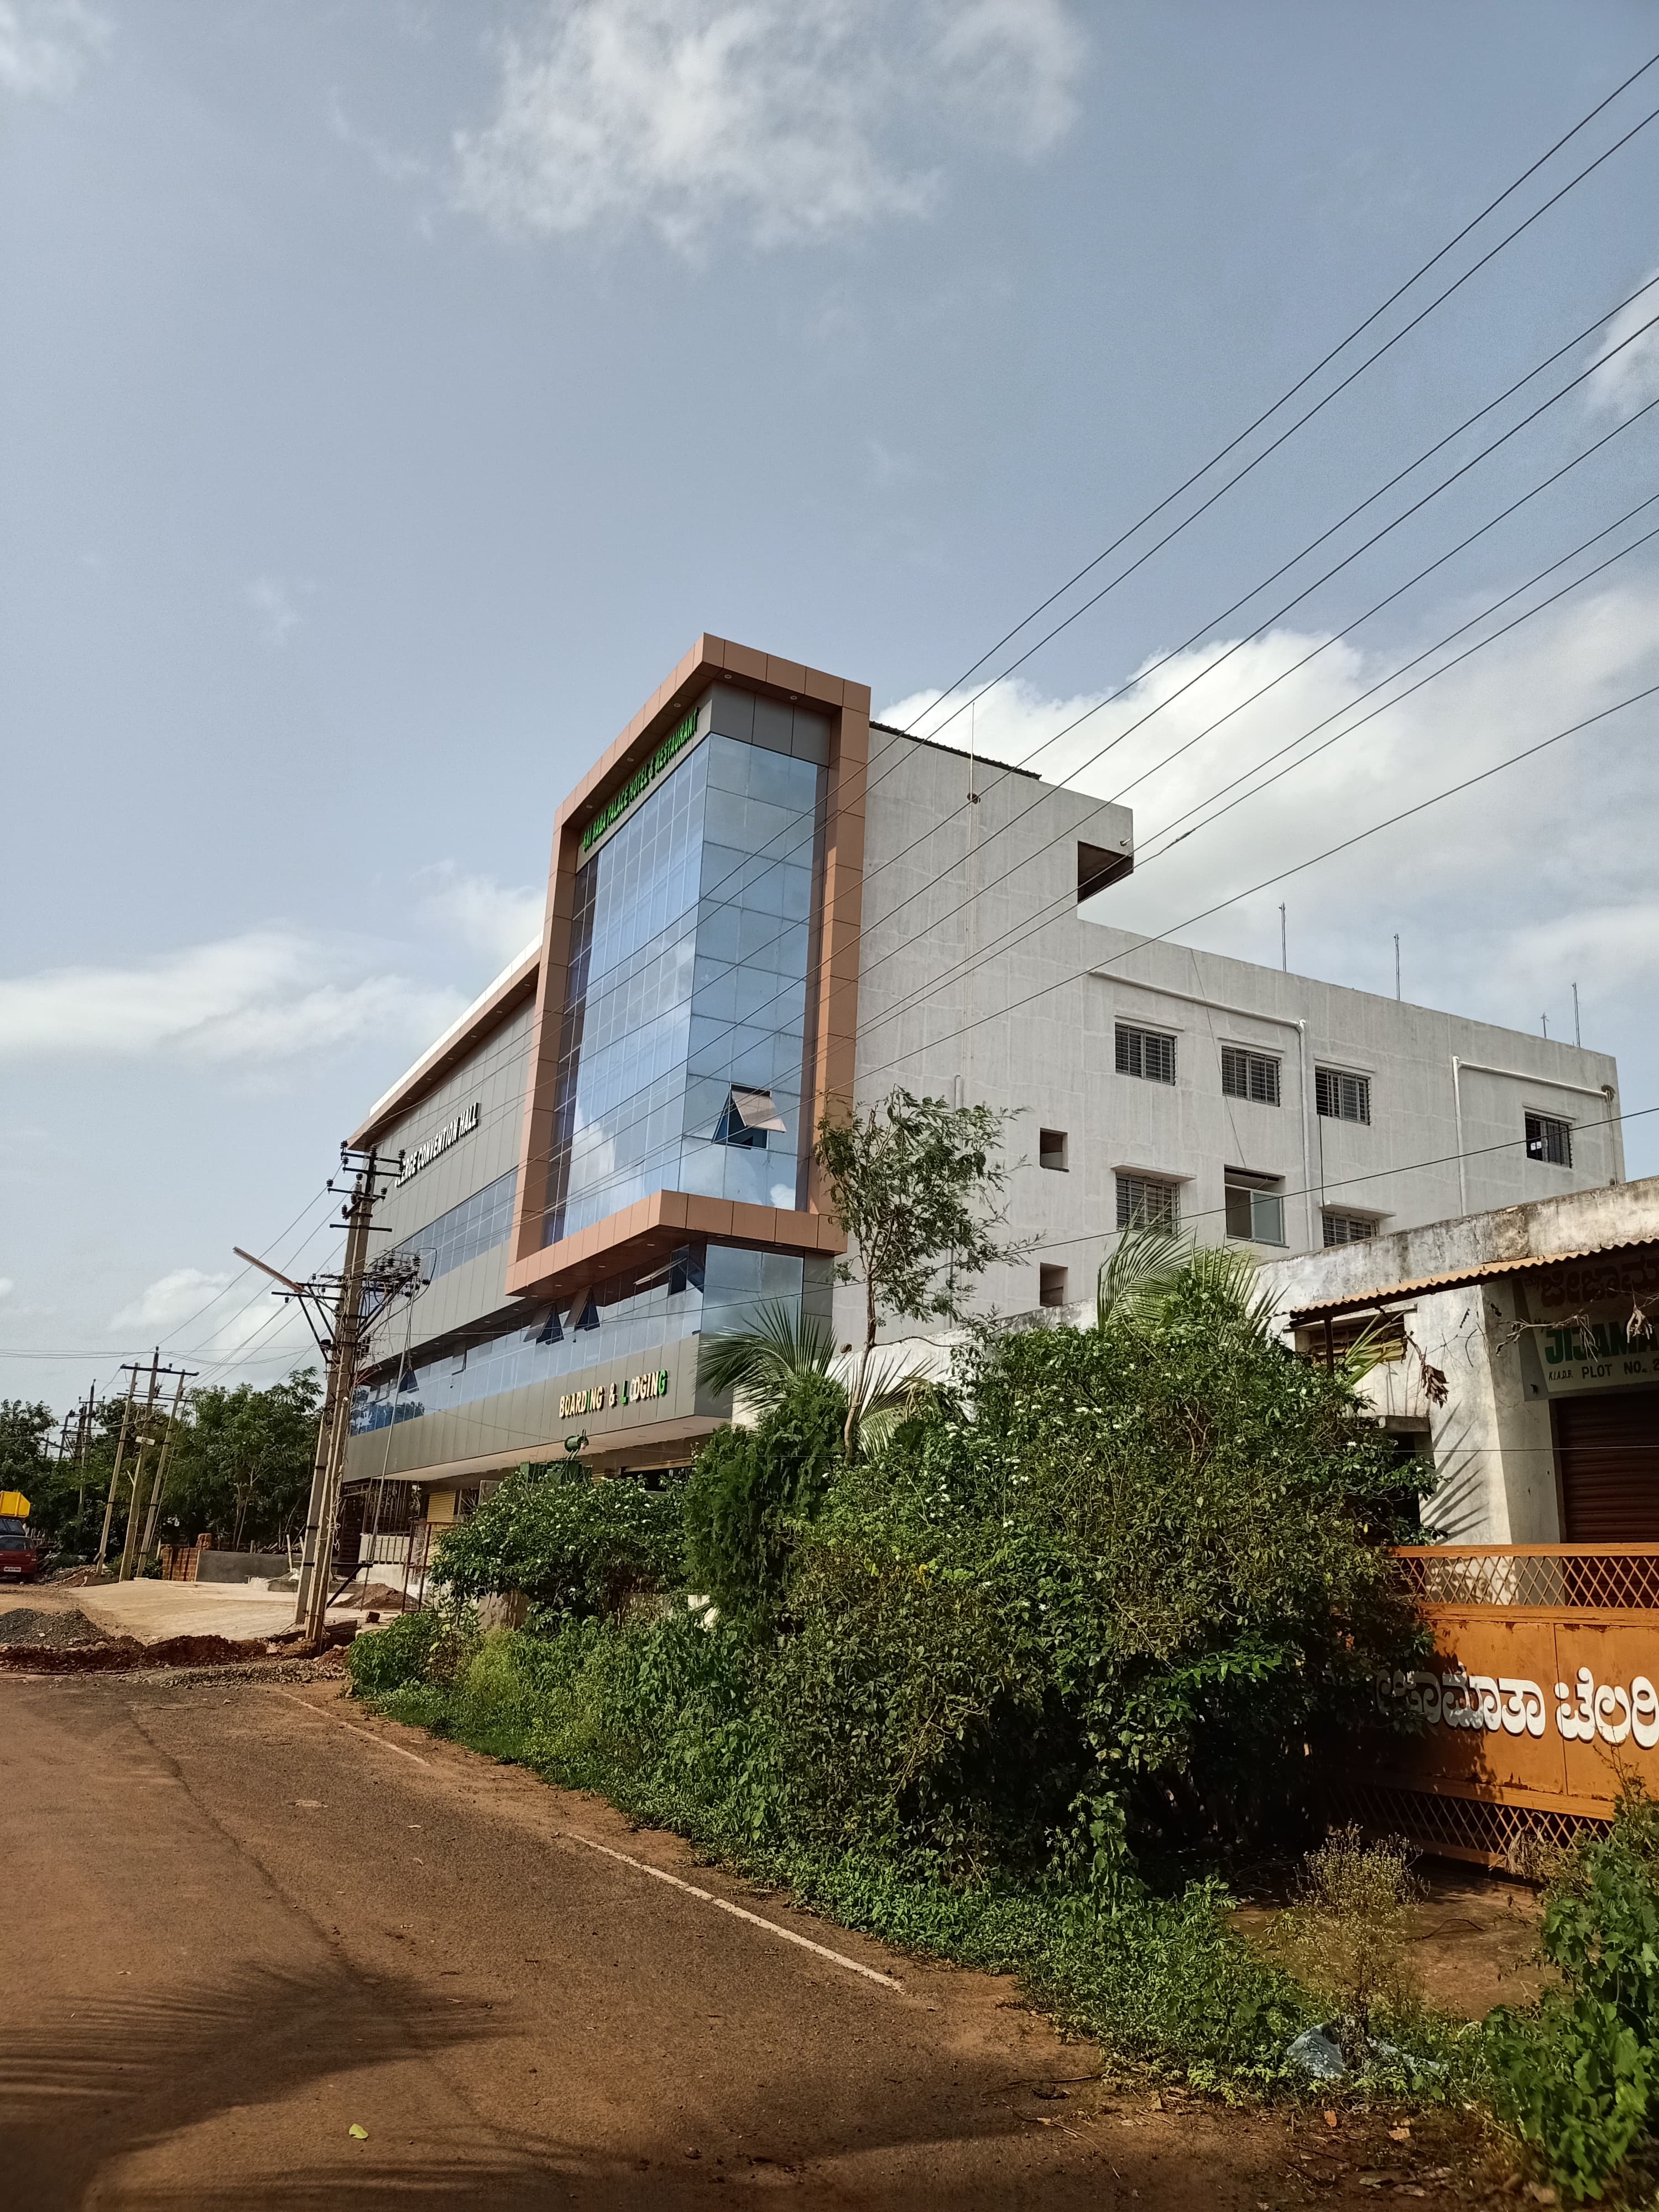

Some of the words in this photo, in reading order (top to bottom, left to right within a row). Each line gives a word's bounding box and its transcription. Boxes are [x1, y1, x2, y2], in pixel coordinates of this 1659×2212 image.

[607, 789, 629, 826] PALACE
[629, 764, 649, 802] HOTEL
[649, 757, 655, 780] &
[655, 707, 699, 773] RESTAURANT
[417, 1117, 461, 1170] CONVENTION
[458, 1102, 479, 1138] HALL
[1582, 1364, 1613, 1379] PLOT
[559, 1386, 605, 1418] BOARDING
[609, 1383, 617, 1407] &
